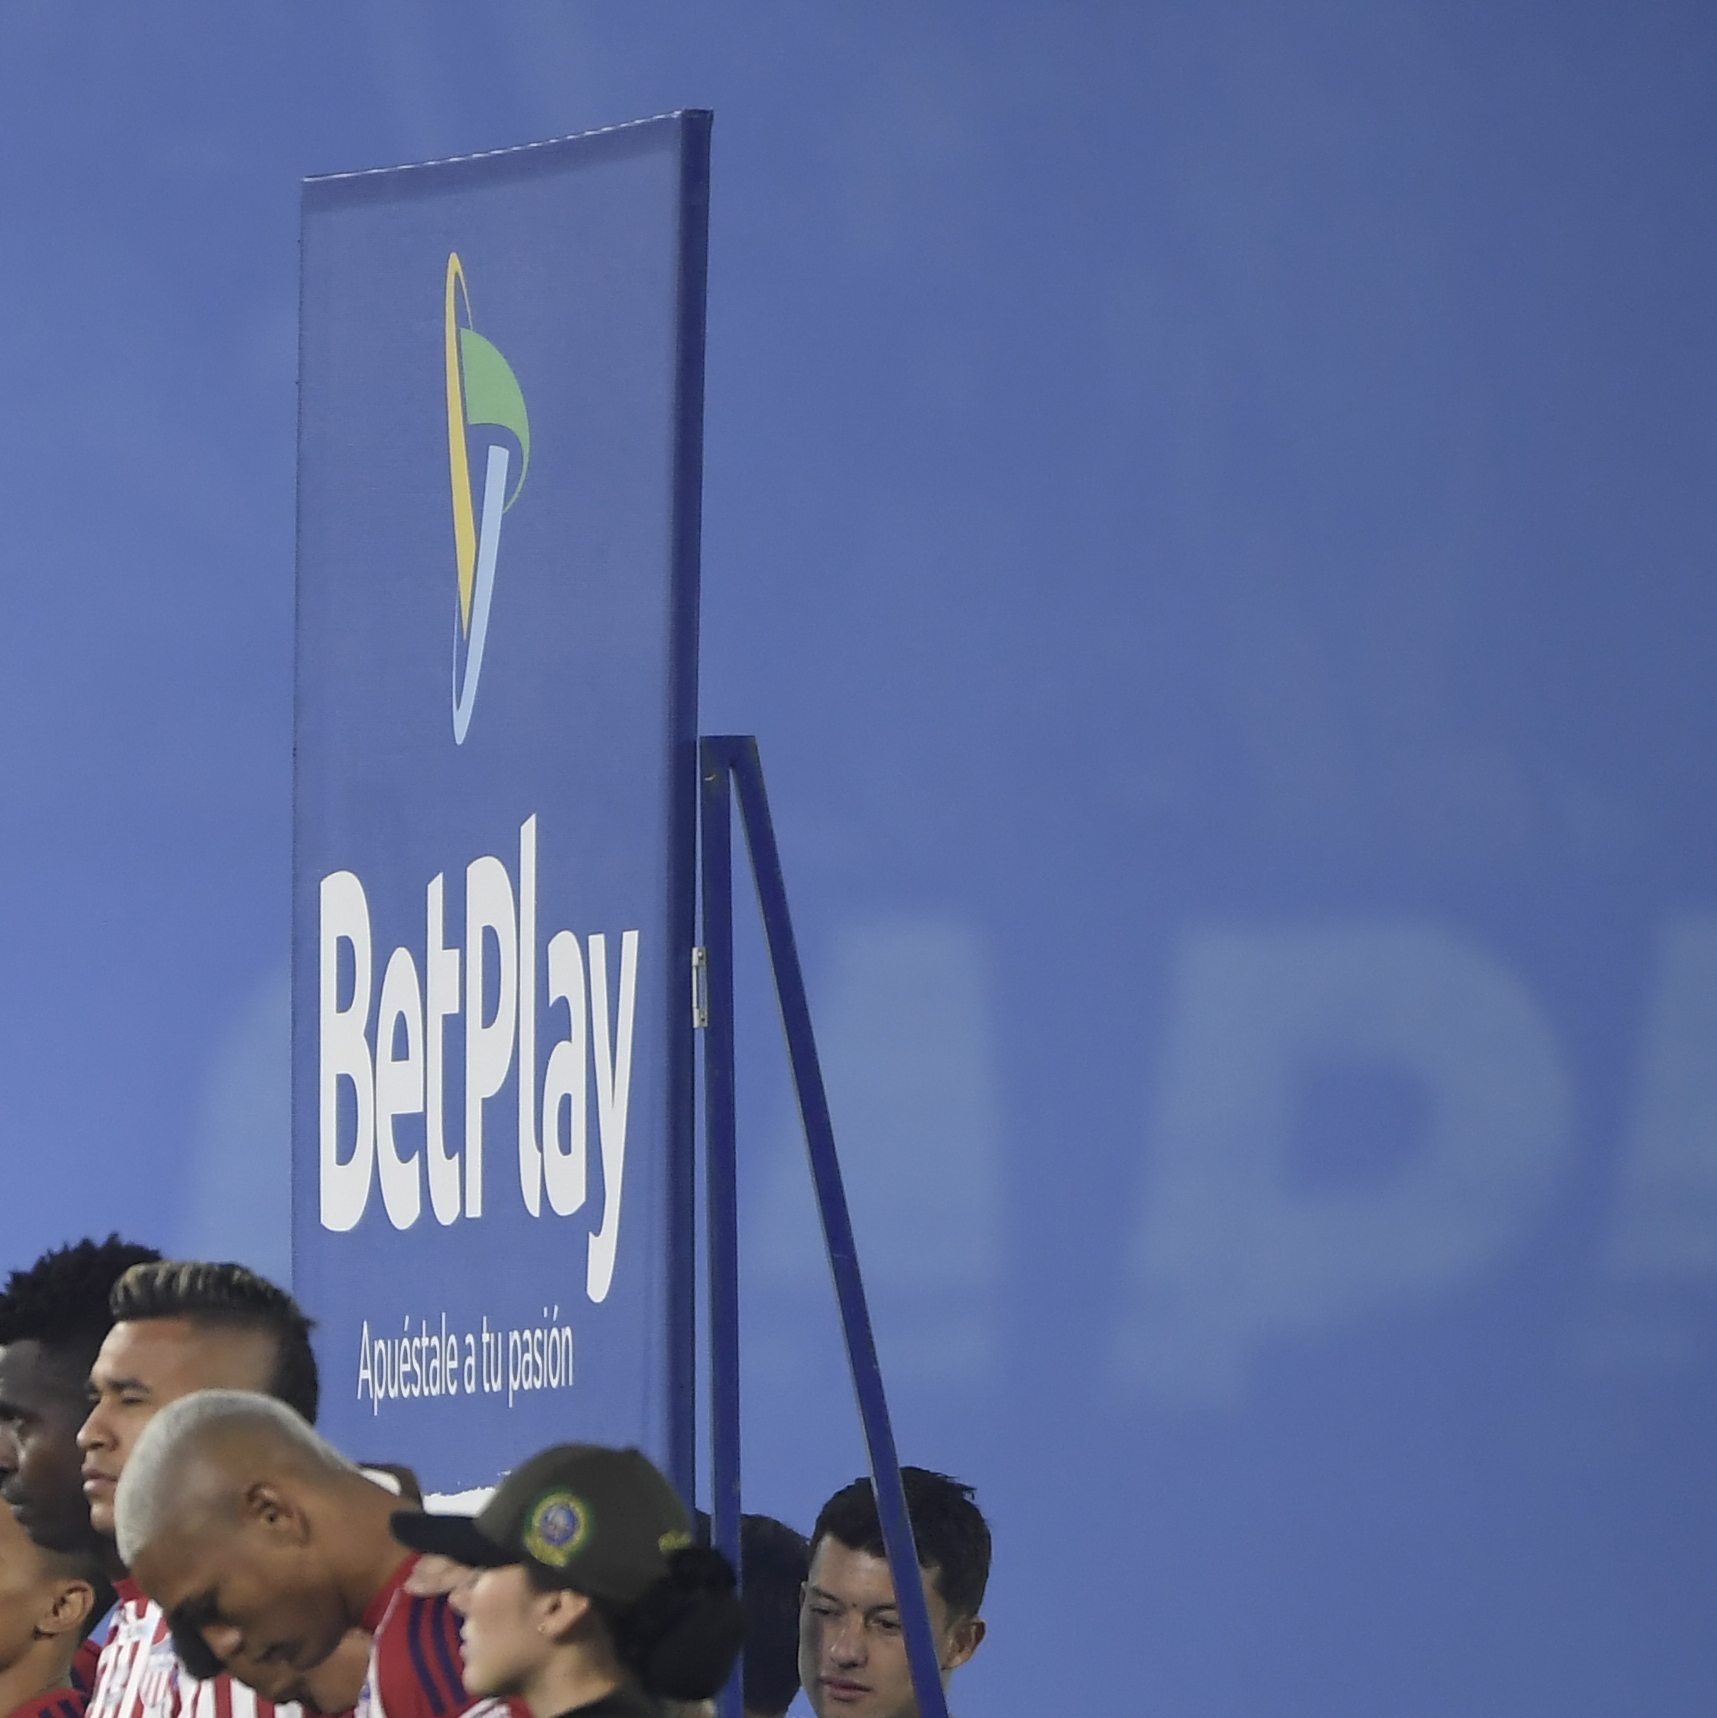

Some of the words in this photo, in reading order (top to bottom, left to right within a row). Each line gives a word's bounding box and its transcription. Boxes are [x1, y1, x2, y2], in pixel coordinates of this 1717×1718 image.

[319, 813, 639, 1303] BetPlay
[357, 1311, 459, 1416] Apuéstale
[464, 1332, 476, 1394] a
[481, 1315, 502, 1392] tu
[508, 1304, 573, 1408] pasión
